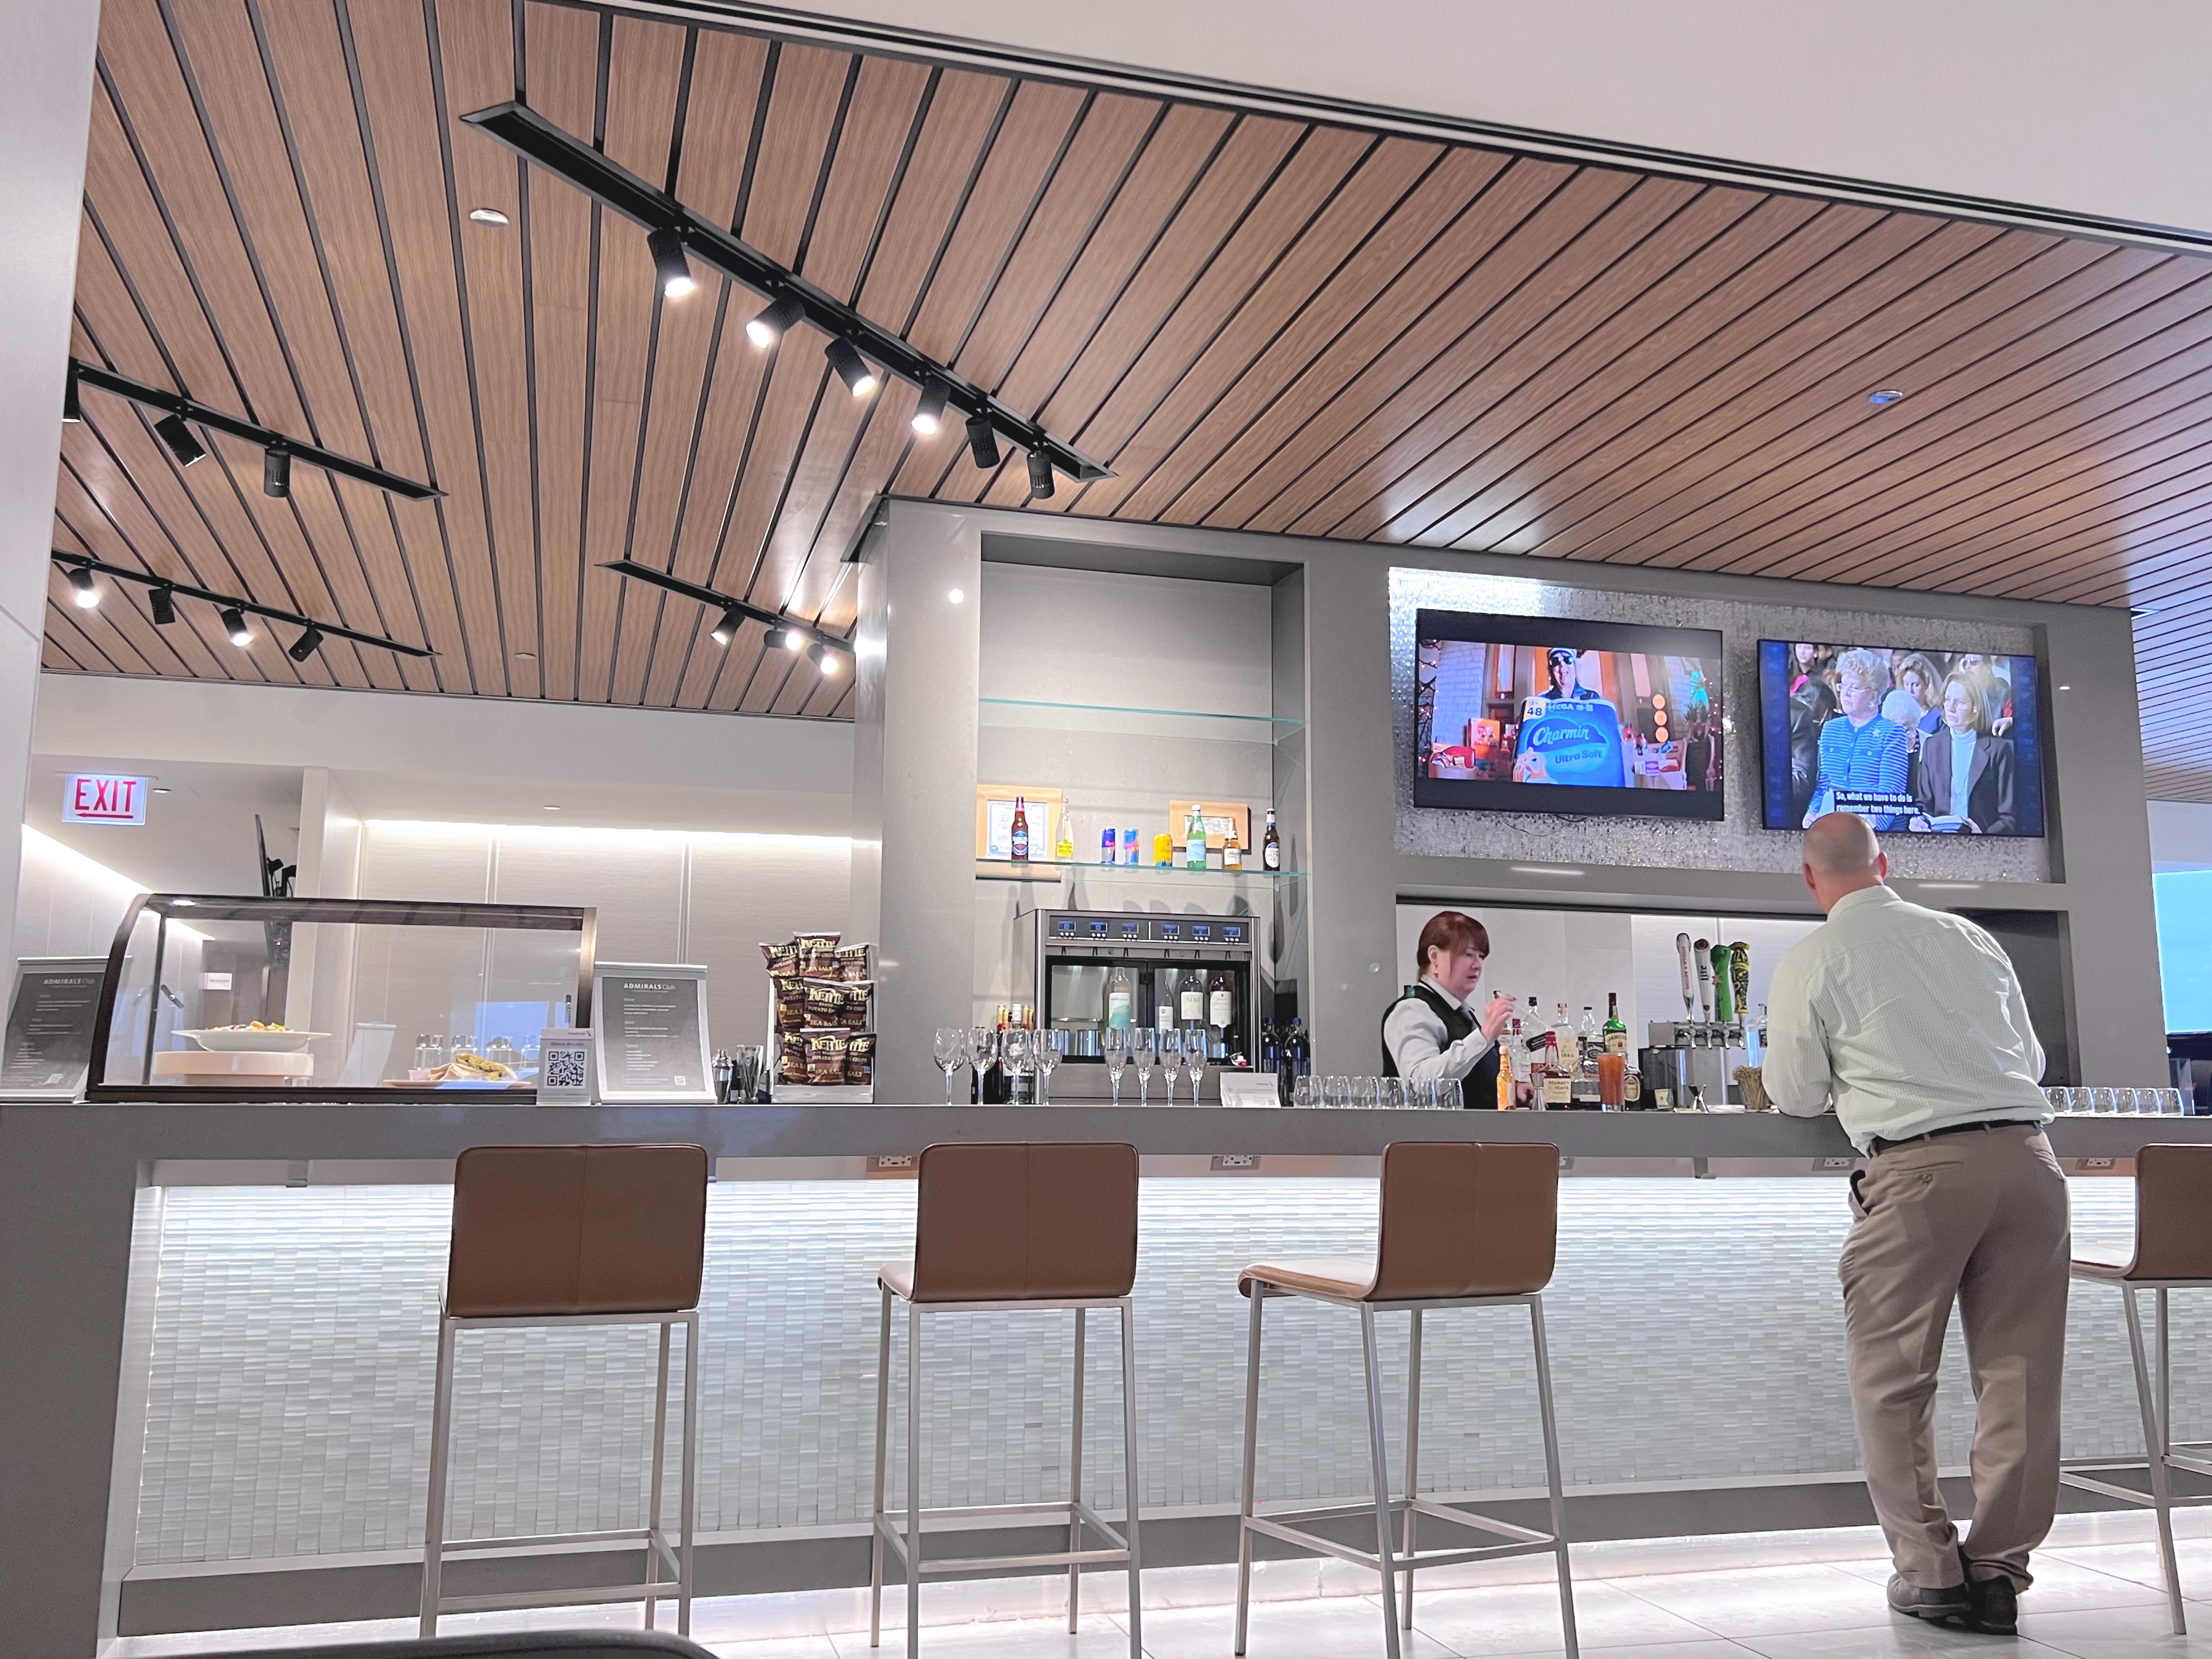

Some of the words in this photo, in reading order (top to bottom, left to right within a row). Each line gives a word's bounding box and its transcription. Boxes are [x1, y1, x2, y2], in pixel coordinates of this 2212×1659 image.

[1527, 708, 1542, 716] 48
[1533, 725, 1590, 746] Charmin
[1555, 753, 1580, 764] Ultra
[1582, 750, 1601, 759] Soft
[75, 778, 137, 812] EXIT
[1836, 792, 1847, 801] So,
[1847, 792, 1863, 800] what
[1874, 793, 1888, 802] have
[1906, 794, 1912, 802] is
[1837, 804, 1870, 812] remember
[1871, 805, 1883, 813] two
[1883, 805, 1903, 815] things
[1904, 805, 1920, 814] here.
